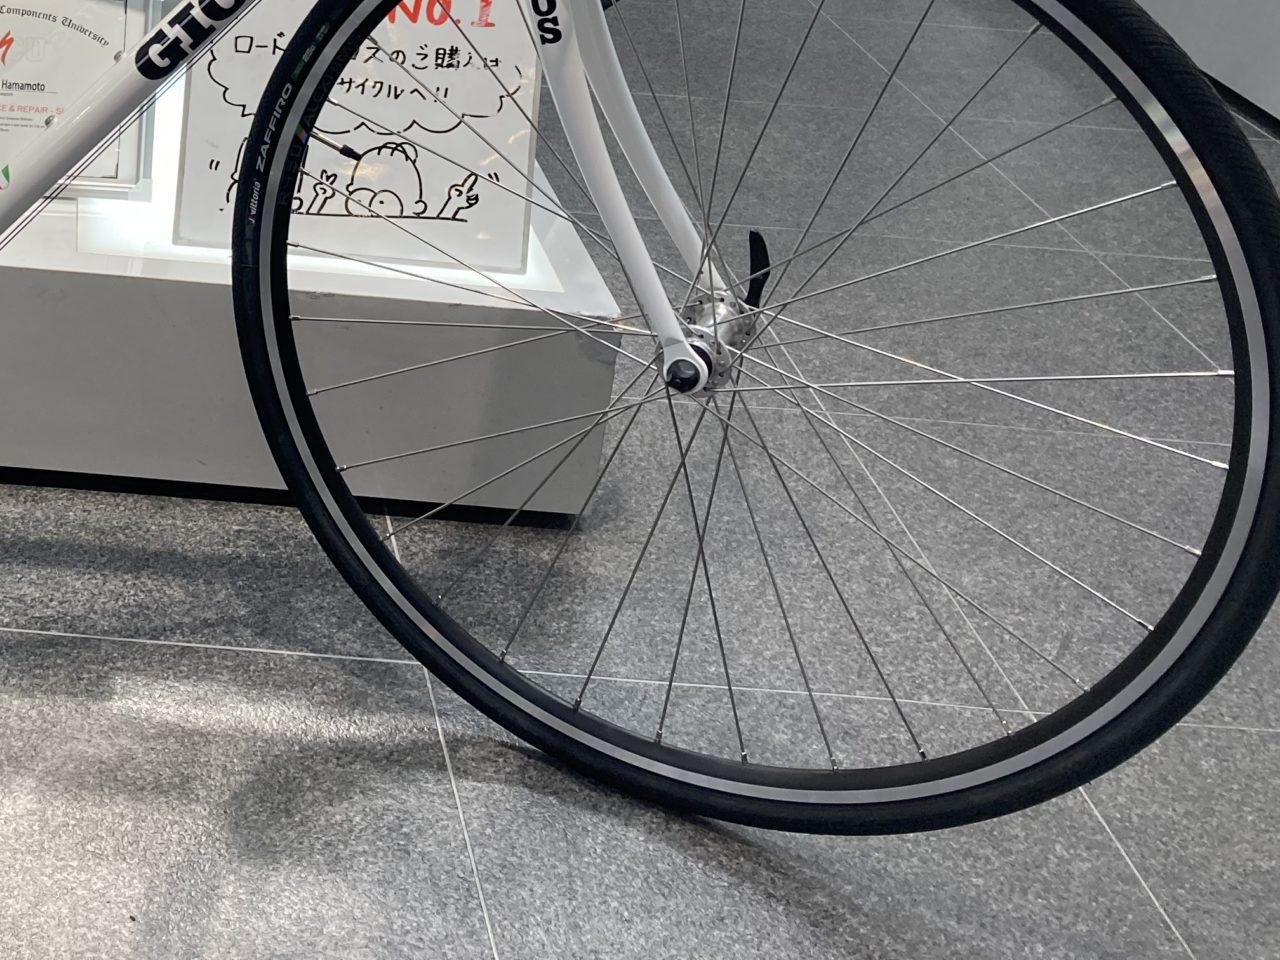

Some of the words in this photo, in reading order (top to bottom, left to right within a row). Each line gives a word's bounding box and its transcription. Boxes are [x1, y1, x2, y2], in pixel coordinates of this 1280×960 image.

[61, 15, 110, 48] University
[1, 79, 46, 92] Hamamoto
[17, 105, 48, 115] REPAIR
[248, 180, 262, 215] vittoria
[256, 82, 293, 172] ZAFFIRO
